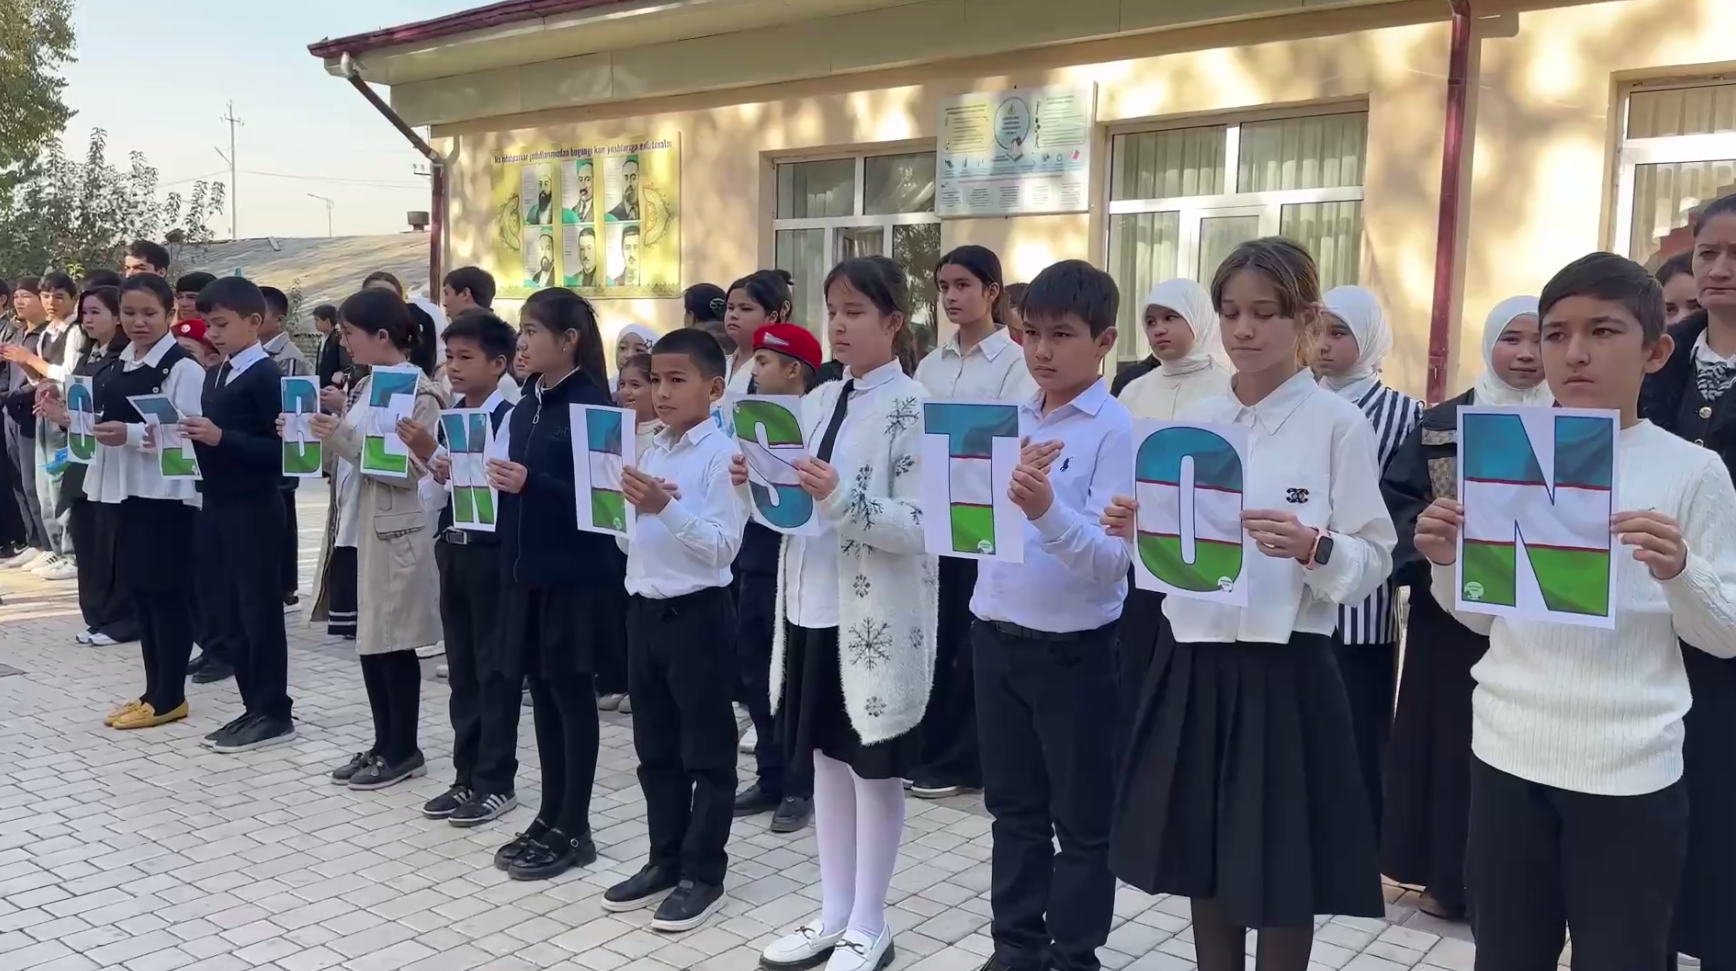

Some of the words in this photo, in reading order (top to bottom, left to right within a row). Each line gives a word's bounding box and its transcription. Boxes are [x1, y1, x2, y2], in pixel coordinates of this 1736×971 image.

[281, 379, 320, 473] B
[363, 371, 418, 473] E
[732, 400, 813, 528] S
[923, 402, 1019, 555] T
[1135, 426, 1243, 592] O
[1463, 413, 1614, 617] N
